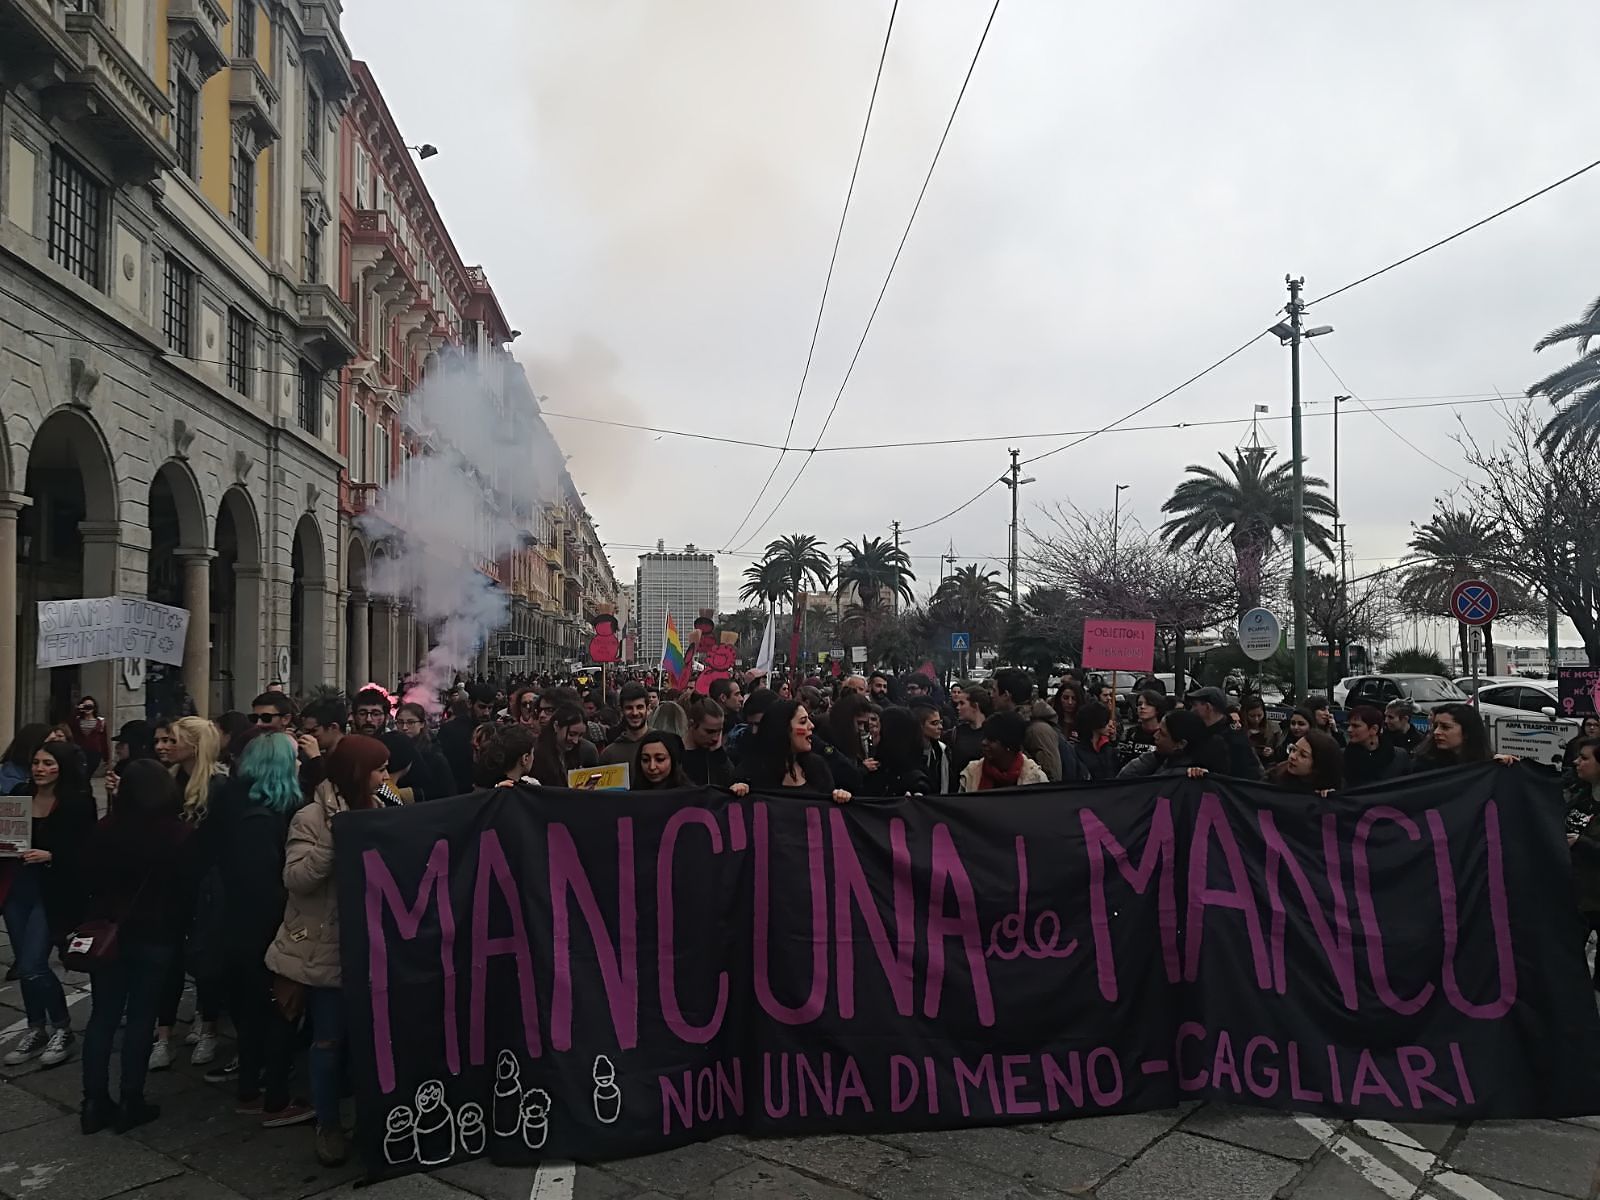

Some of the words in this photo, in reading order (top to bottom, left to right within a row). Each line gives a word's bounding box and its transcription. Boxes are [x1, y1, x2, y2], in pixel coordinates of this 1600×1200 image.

[41, 600, 112, 632] SIAMO
[985, 834, 1078, 960] de
[1079, 792, 1518, 1019] MANCU
[659, 1057, 744, 1135] NON
[764, 1051, 873, 1119] UNA
[890, 1053, 939, 1115] DI
[952, 1046, 1124, 1117] MENO
[1175, 1021, 1476, 1109] CAGLIARI
